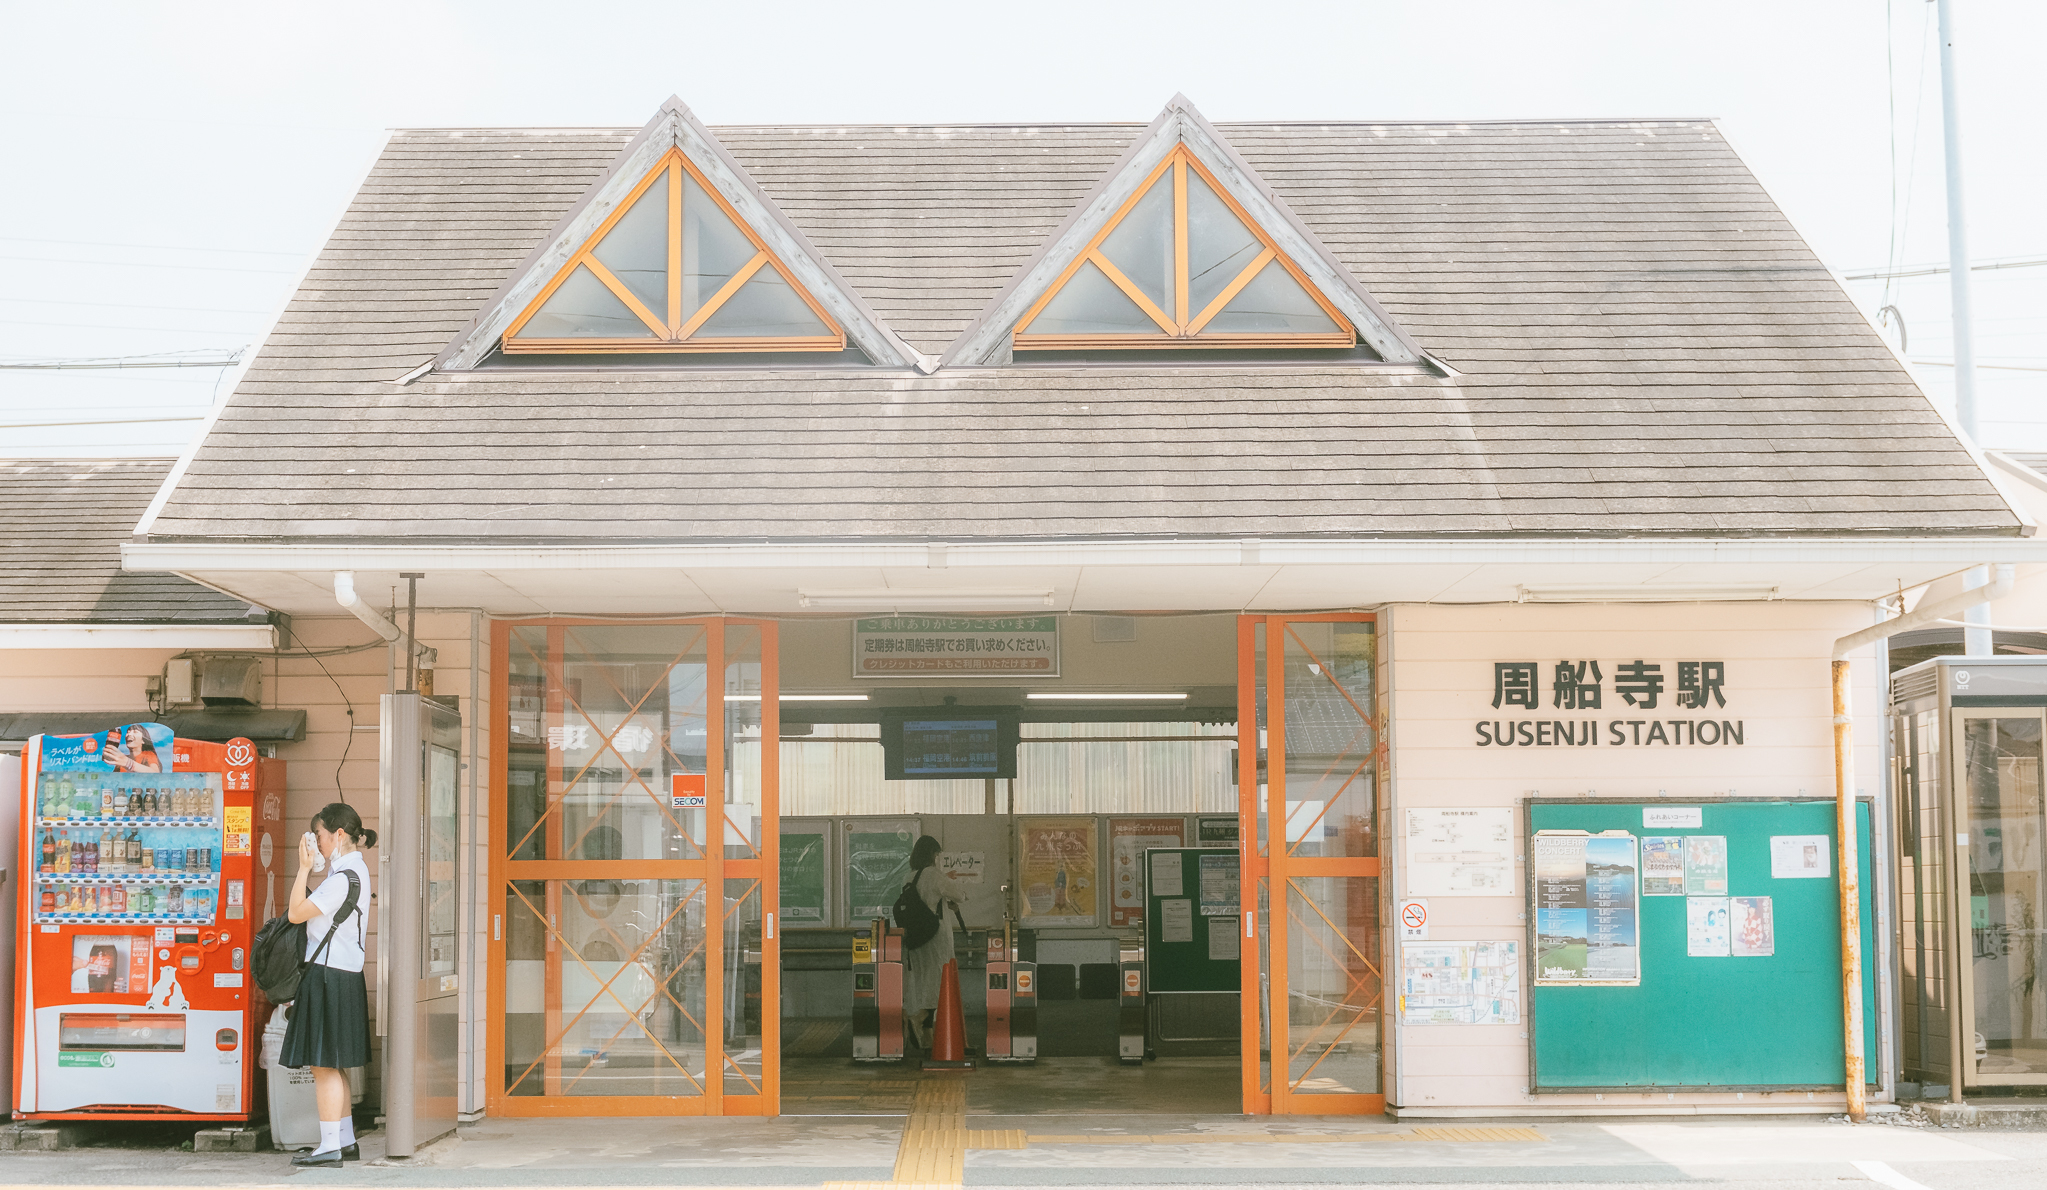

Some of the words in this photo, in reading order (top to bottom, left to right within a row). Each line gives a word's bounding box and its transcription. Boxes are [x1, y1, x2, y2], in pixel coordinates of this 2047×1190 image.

[864, 638, 1051, 653] 定期券は周船寺駅でお買い求めください。
[1491, 660, 1727, 710] 周船寺駅
[1475, 720, 1598, 747] SUSENJI
[1608, 719, 1745, 747] STATION
[51, 745, 82, 757] ラベルが
[674, 797, 704, 805] SECOM
[1538, 838, 1590, 847] WILDBERRY
[1538, 847, 1581, 855] CONCERT
[988, 937, 1003, 948] IC
